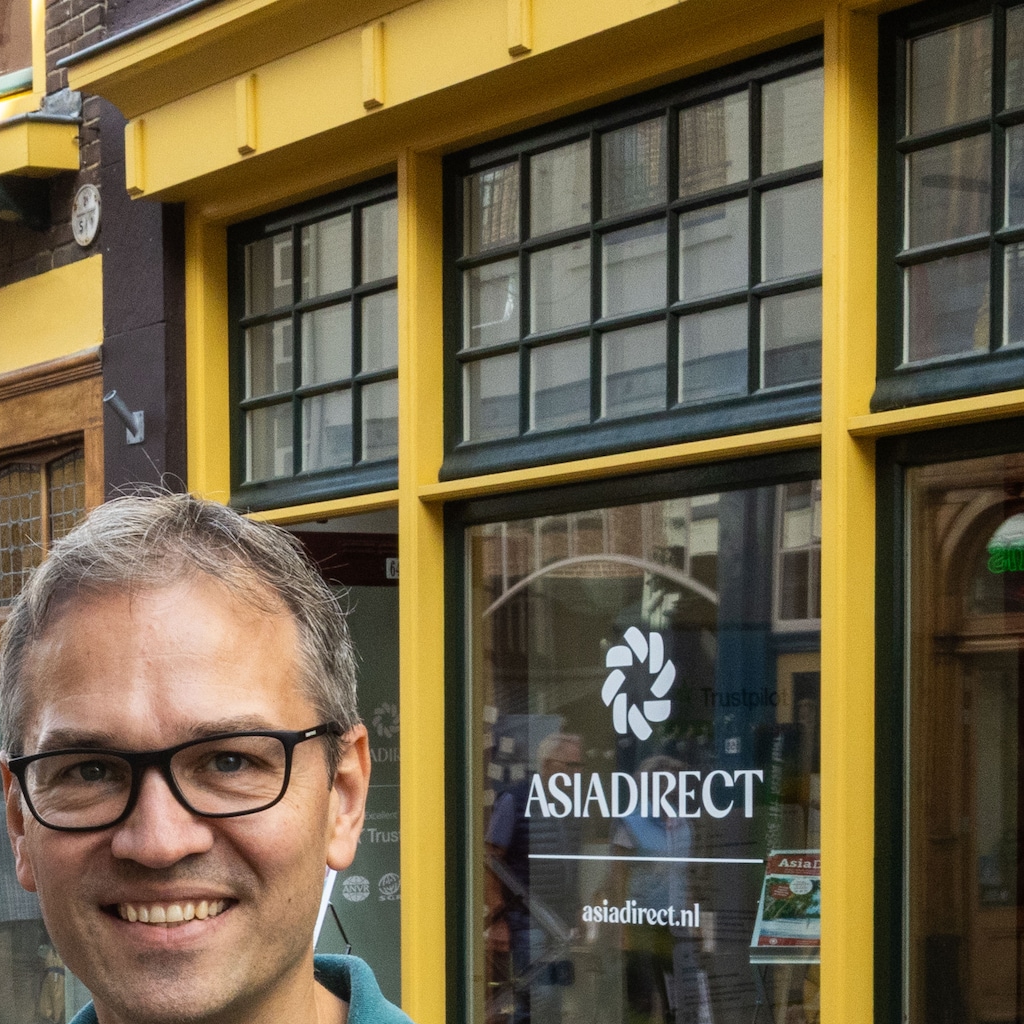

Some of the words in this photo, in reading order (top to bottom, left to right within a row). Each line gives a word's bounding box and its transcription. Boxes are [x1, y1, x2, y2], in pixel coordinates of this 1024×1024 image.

[700, 686, 791, 710] Trustpilot
[524, 769, 764, 819] ASIADIRECT
[581, 898, 701, 928] asiadirect.nl
